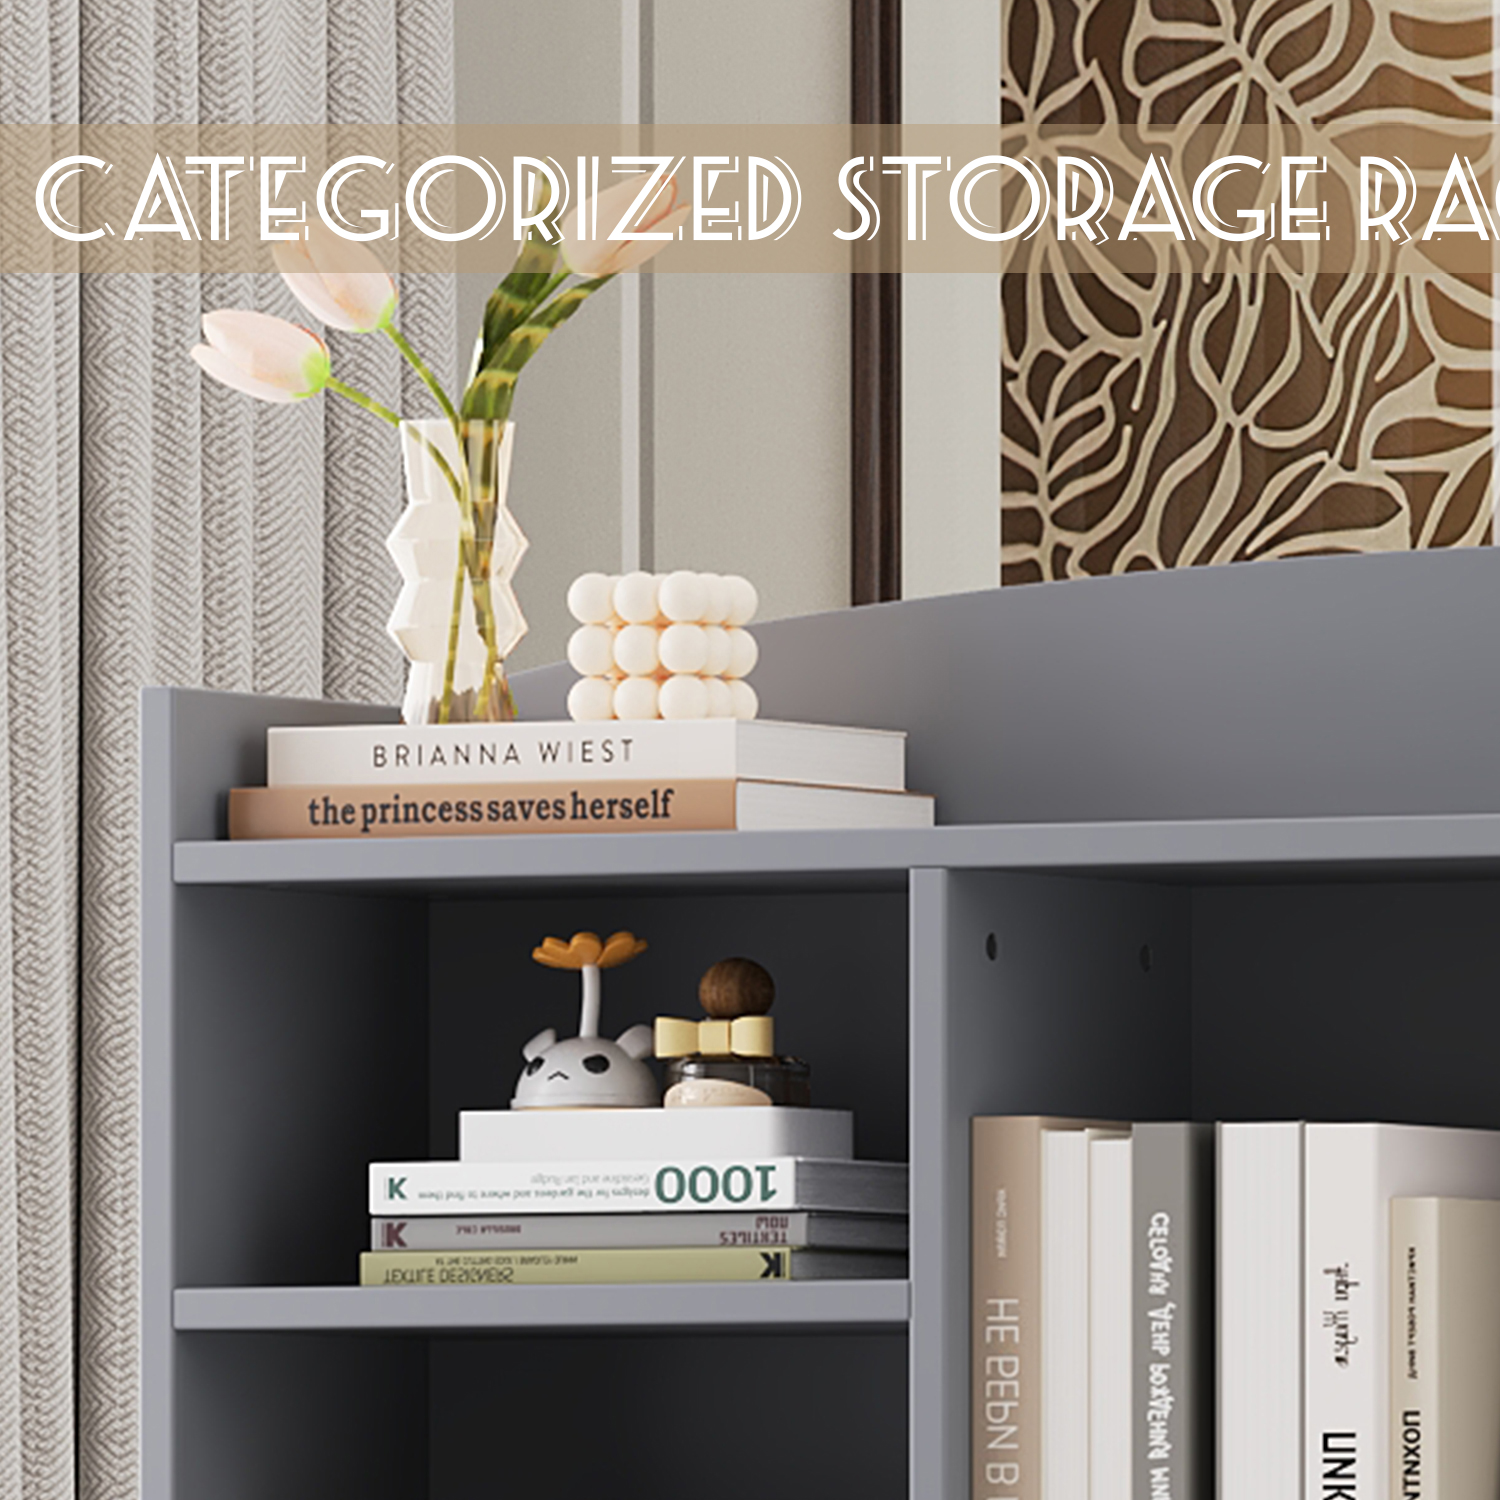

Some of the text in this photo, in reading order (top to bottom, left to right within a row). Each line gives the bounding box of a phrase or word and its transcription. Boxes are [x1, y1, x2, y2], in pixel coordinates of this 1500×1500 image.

[373, 738, 634, 769] BRIANNA WIEST
[308, 788, 676, 833] the princess saves herself
[654, 1164, 778, 1204] 1000
